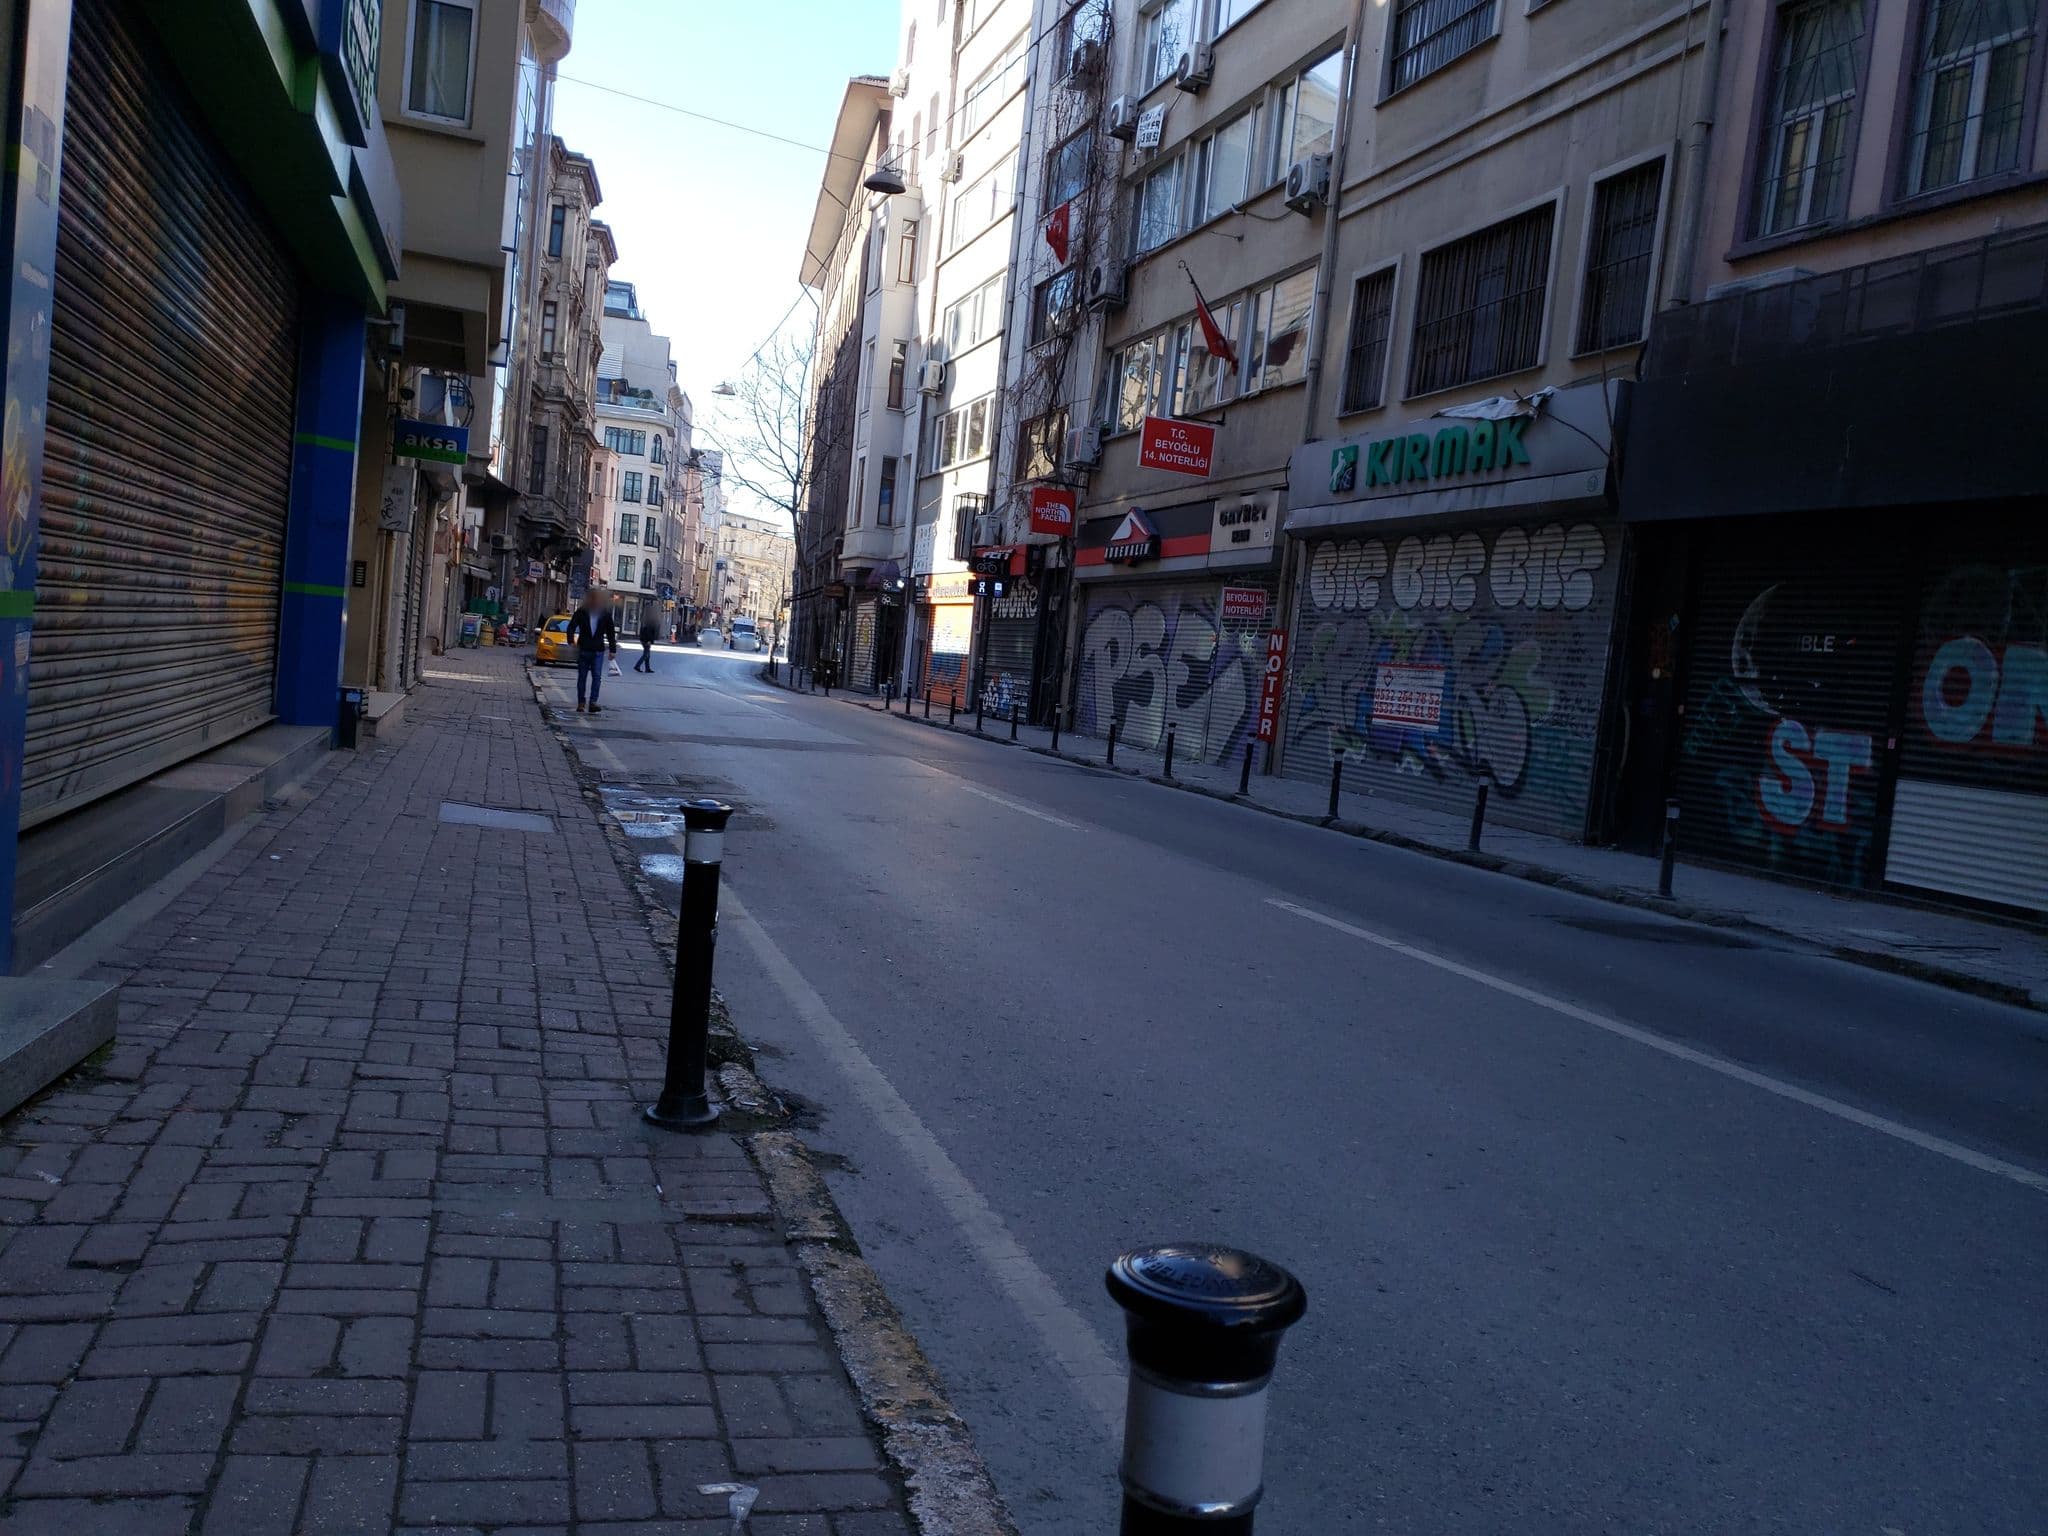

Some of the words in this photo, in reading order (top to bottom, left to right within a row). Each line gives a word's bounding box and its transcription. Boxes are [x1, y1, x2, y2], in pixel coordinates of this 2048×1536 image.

[404, 433, 458, 452] aksa
[1171, 428, 1189, 441] T.C.
[1155, 438, 1201, 455] BEYOĞLU
[1366, 416, 1530, 487] KIRMAK
[1144, 449, 1157, 461] 14.
[1159, 452, 1209, 469] NOTERLİĞİ
[1035, 506, 1059, 516] NORTH
[1046, 501, 1059, 510] THE
[1041, 514, 1061, 522] FACE
[1260, 634, 1284, 736] NOTER
[1757, 719, 1873, 826] ST
